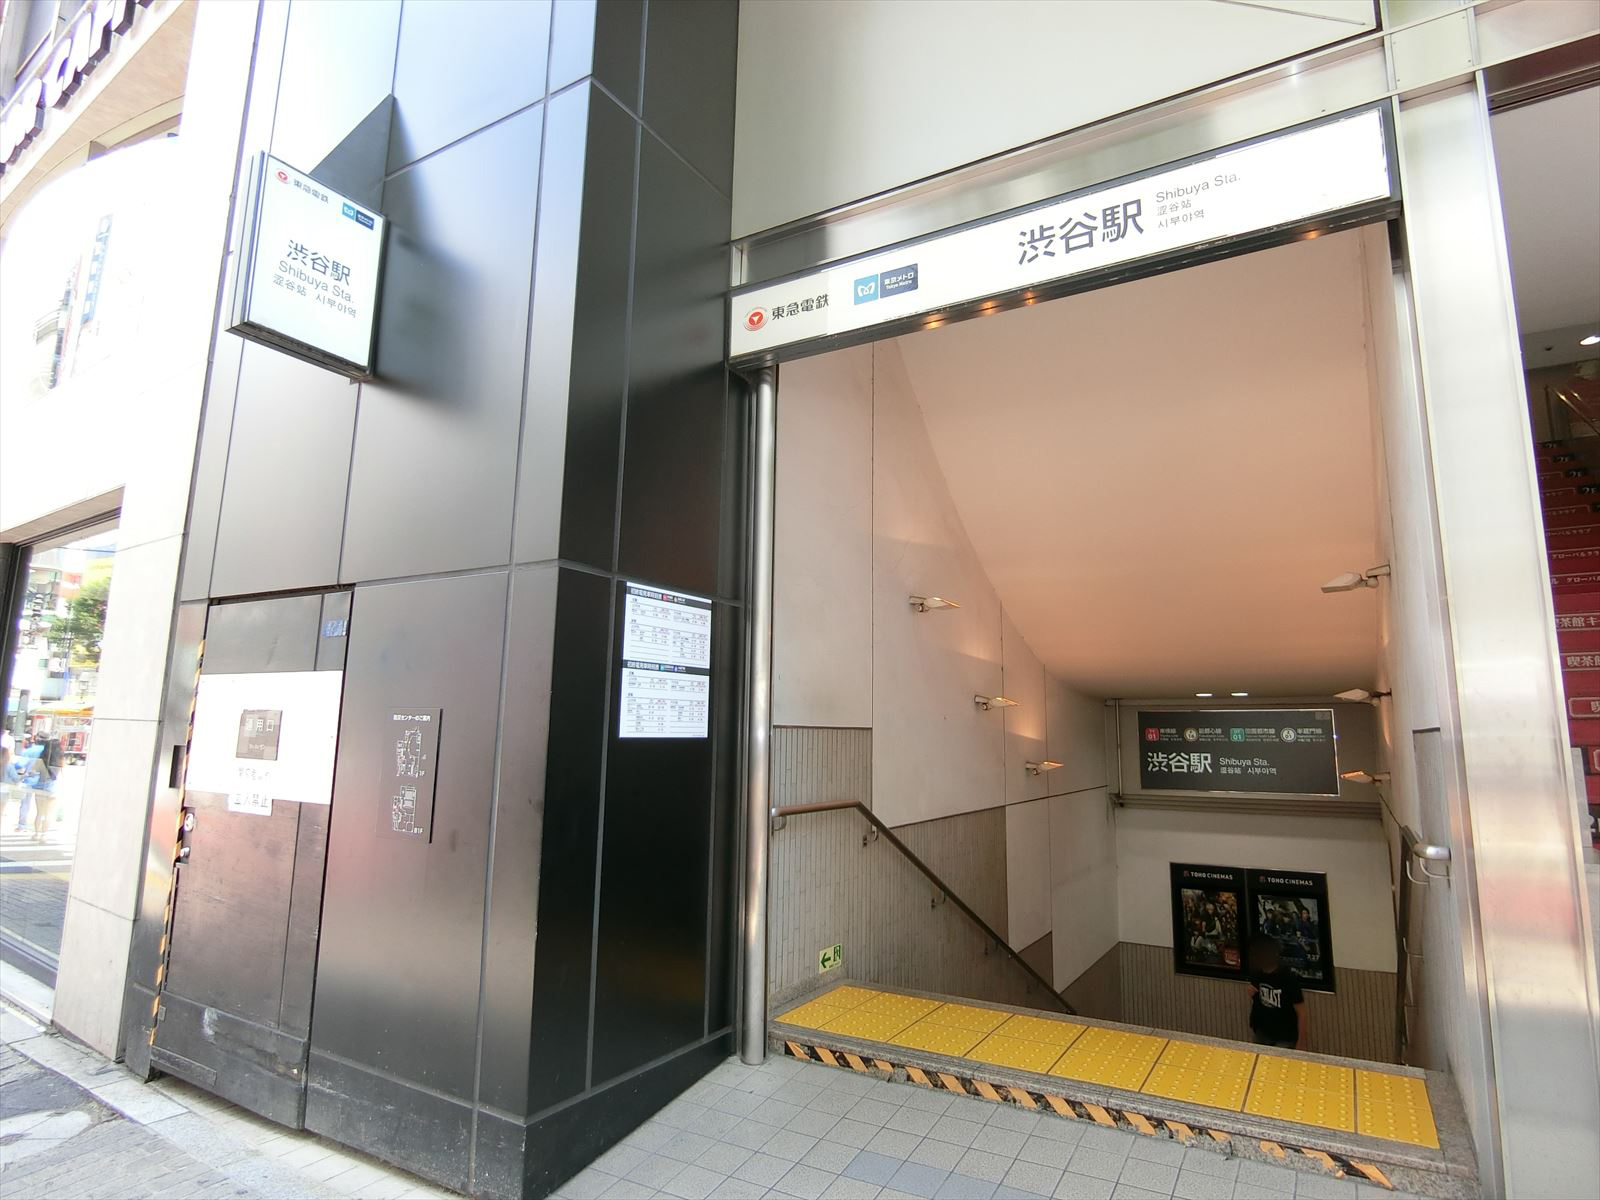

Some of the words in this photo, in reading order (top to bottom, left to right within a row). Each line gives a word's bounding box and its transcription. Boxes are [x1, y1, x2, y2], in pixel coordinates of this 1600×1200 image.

[293, 178, 329, 204] 東急電鉄
[1155, 179, 1210, 202] Shibuya
[1214, 172, 1242, 188] Sta.
[1018, 198, 1145, 266] 渋谷駅
[1157, 208, 1206, 230] 시부야역
[286, 238, 351, 286] 渋谷駅
[278, 260, 329, 292] Shibuya
[332, 284, 355, 305] Sta.
[315, 292, 357, 319] 시부야역
[771, 293, 830, 321] 東急電鉄
[1147, 752, 1212, 774] 渋谷駅
[1219, 757, 1252, 767] Shibuya
[1253, 758, 1270, 766] Sta.
[1284, 878, 1313, 886] CINEMAS
